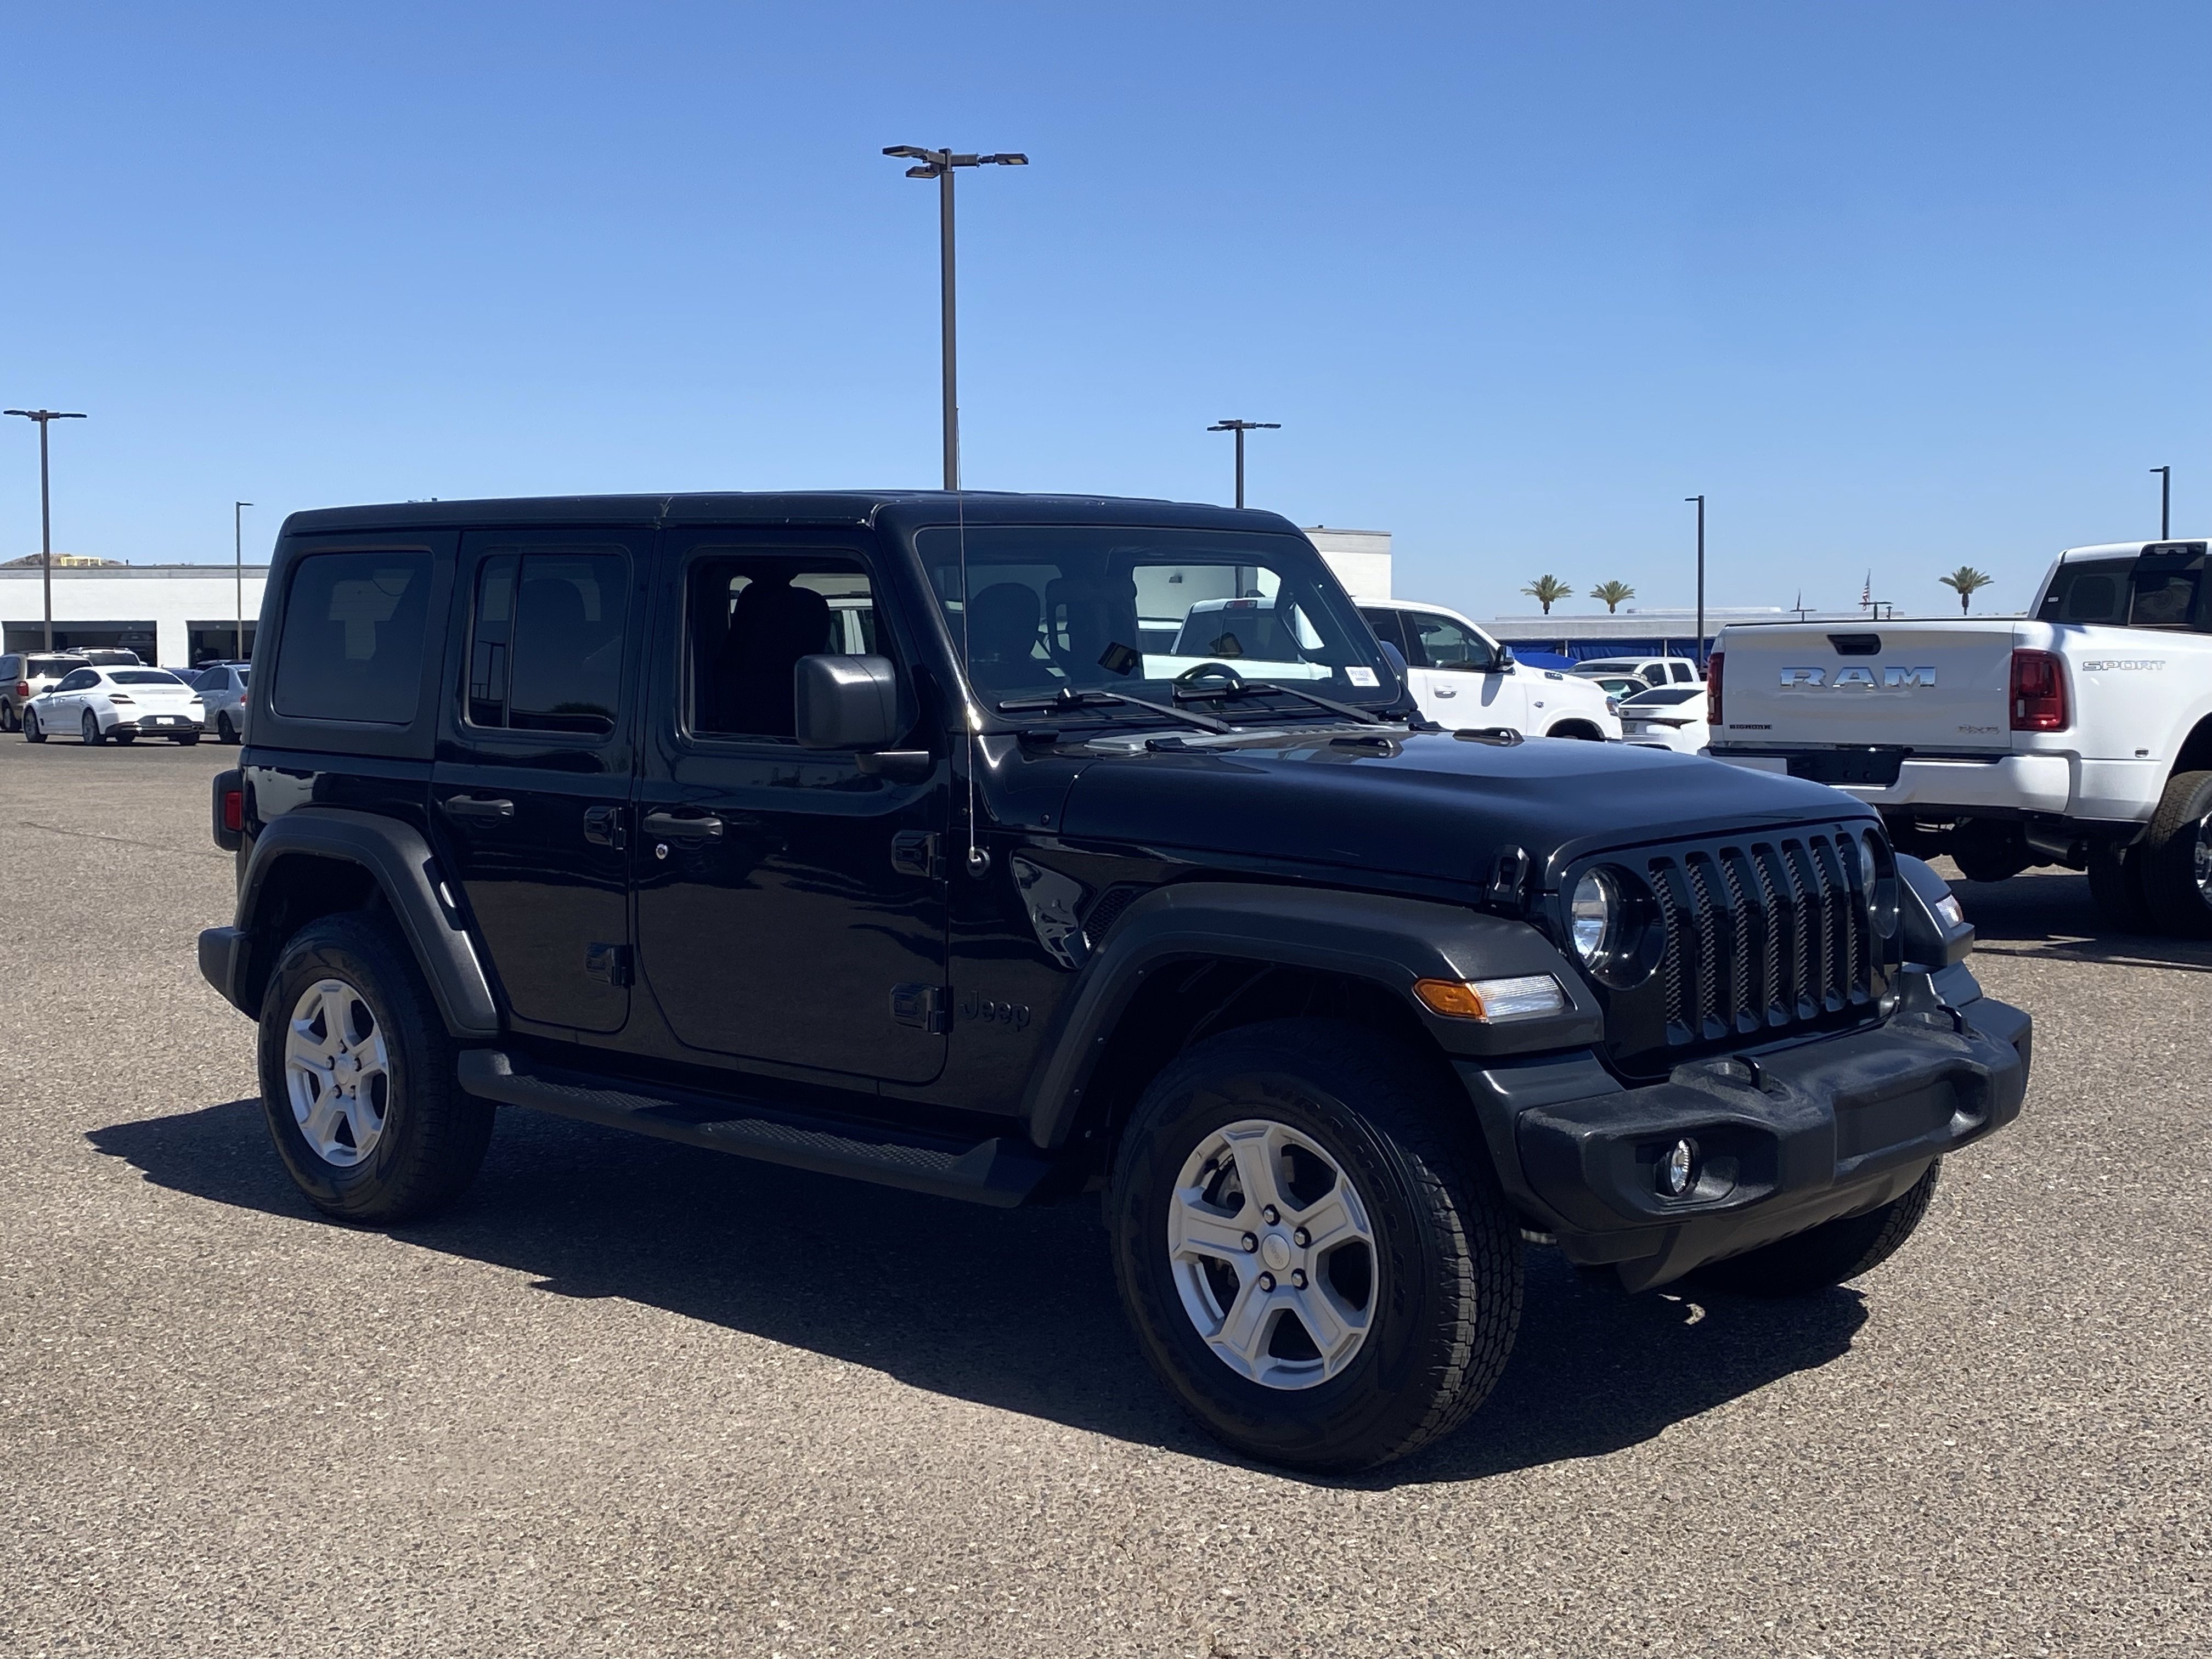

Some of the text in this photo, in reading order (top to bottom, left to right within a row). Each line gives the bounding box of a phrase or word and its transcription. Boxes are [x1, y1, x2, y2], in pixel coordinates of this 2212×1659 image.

[2083, 661, 2165, 671] SPORT
[1781, 667, 1937, 688] RAM
[960, 990, 1031, 1032] Jeep
